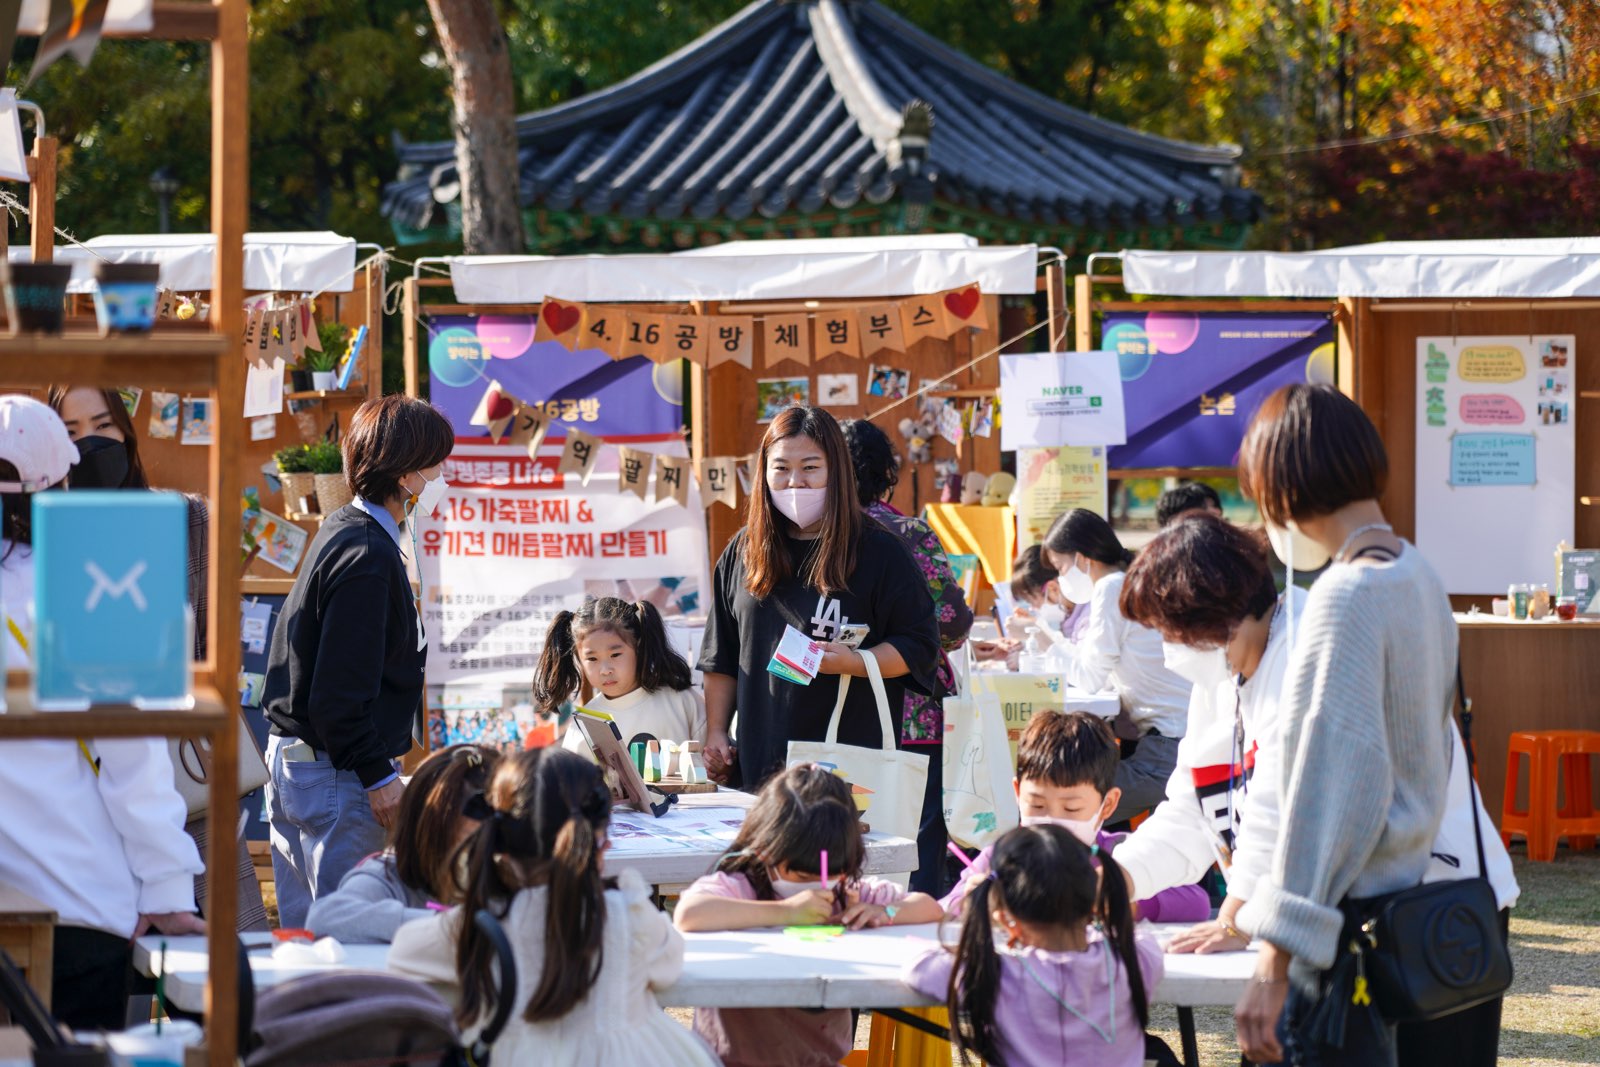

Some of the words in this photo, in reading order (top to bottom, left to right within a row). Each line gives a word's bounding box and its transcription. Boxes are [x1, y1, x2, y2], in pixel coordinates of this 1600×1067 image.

[1042, 385, 1083, 396] NAVER
[513, 462, 554, 484] Life
[577, 500, 594, 522] &
[423, 529, 485, 556] 유기견
[493, 532, 593, 558] 매듭팔찌
[601, 530, 667, 557] 만들기
